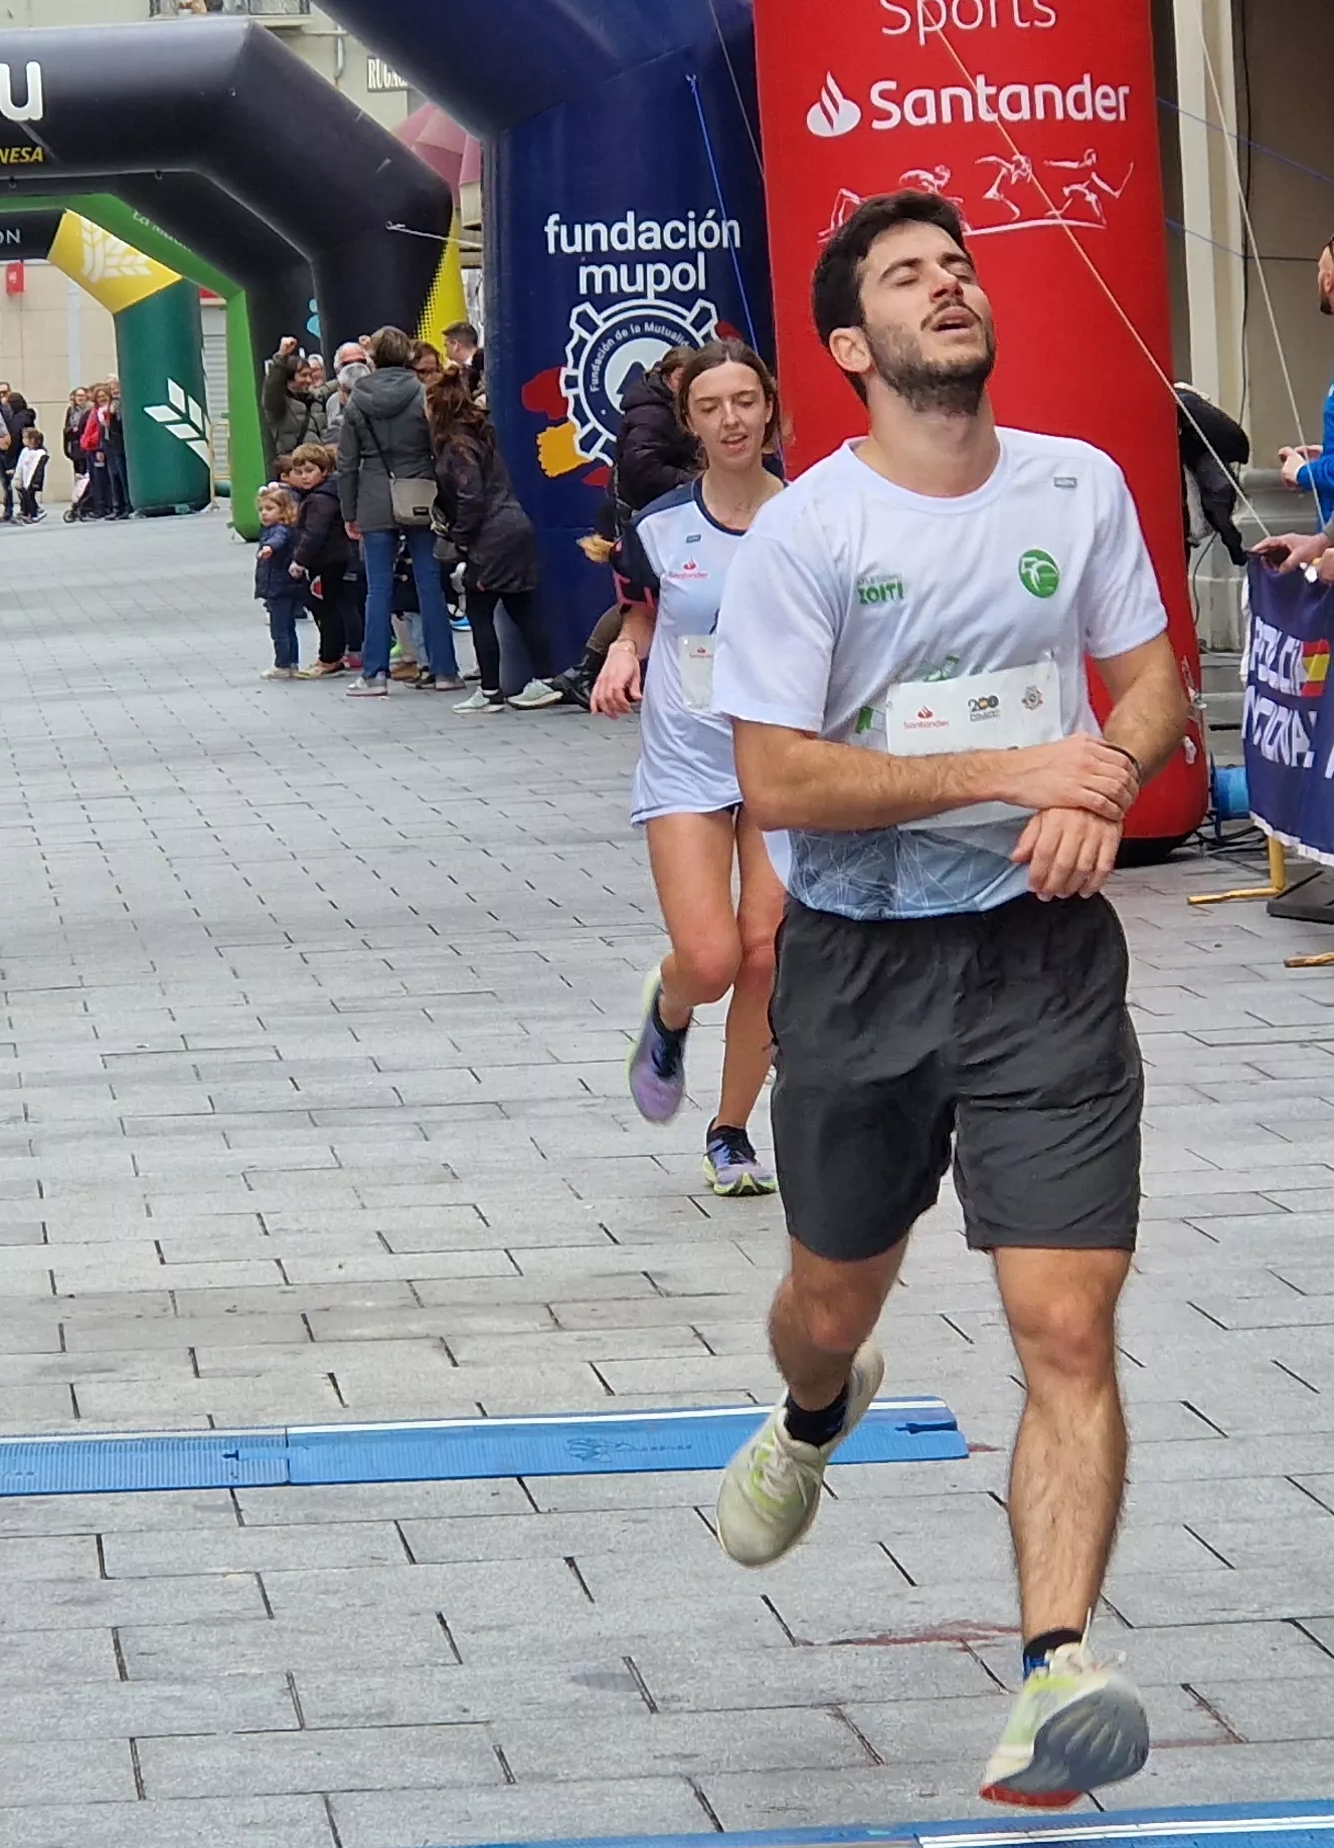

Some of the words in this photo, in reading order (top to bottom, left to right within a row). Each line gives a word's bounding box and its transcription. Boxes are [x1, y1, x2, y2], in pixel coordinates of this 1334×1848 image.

[869, 73, 1130, 131] Santander
[544, 208, 742, 255] fundación
[578, 251, 706, 300] mupol
